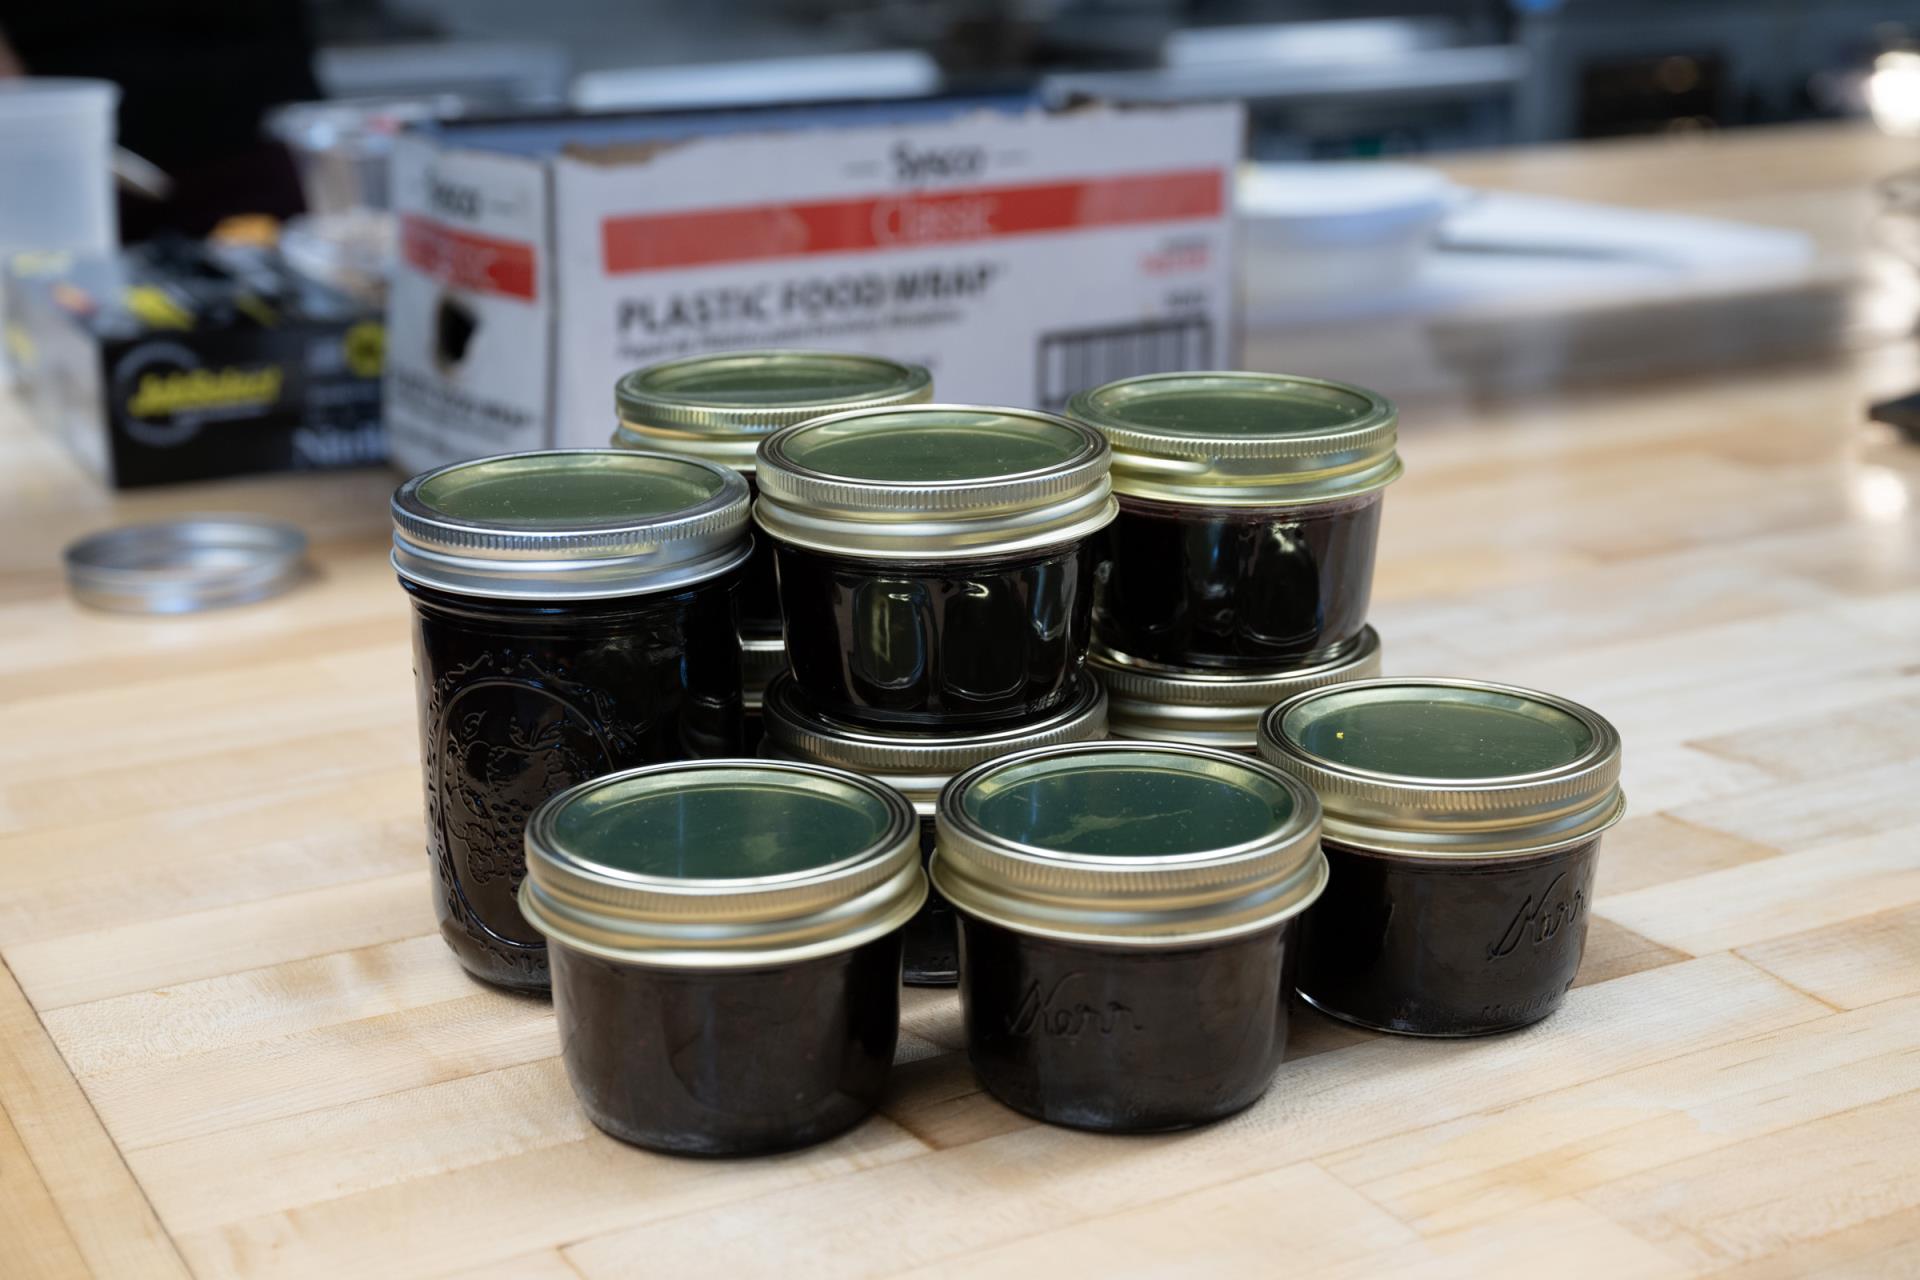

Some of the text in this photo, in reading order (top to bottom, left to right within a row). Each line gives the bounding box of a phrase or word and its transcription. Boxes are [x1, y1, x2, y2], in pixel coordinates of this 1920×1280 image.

[872, 193, 993, 245] Classic
[616, 284, 768, 330] PLASTIC
[780, 272, 888, 316] FOOD
[894, 262, 992, 303] WRAP
[1006, 970, 1144, 1036] Kerr
